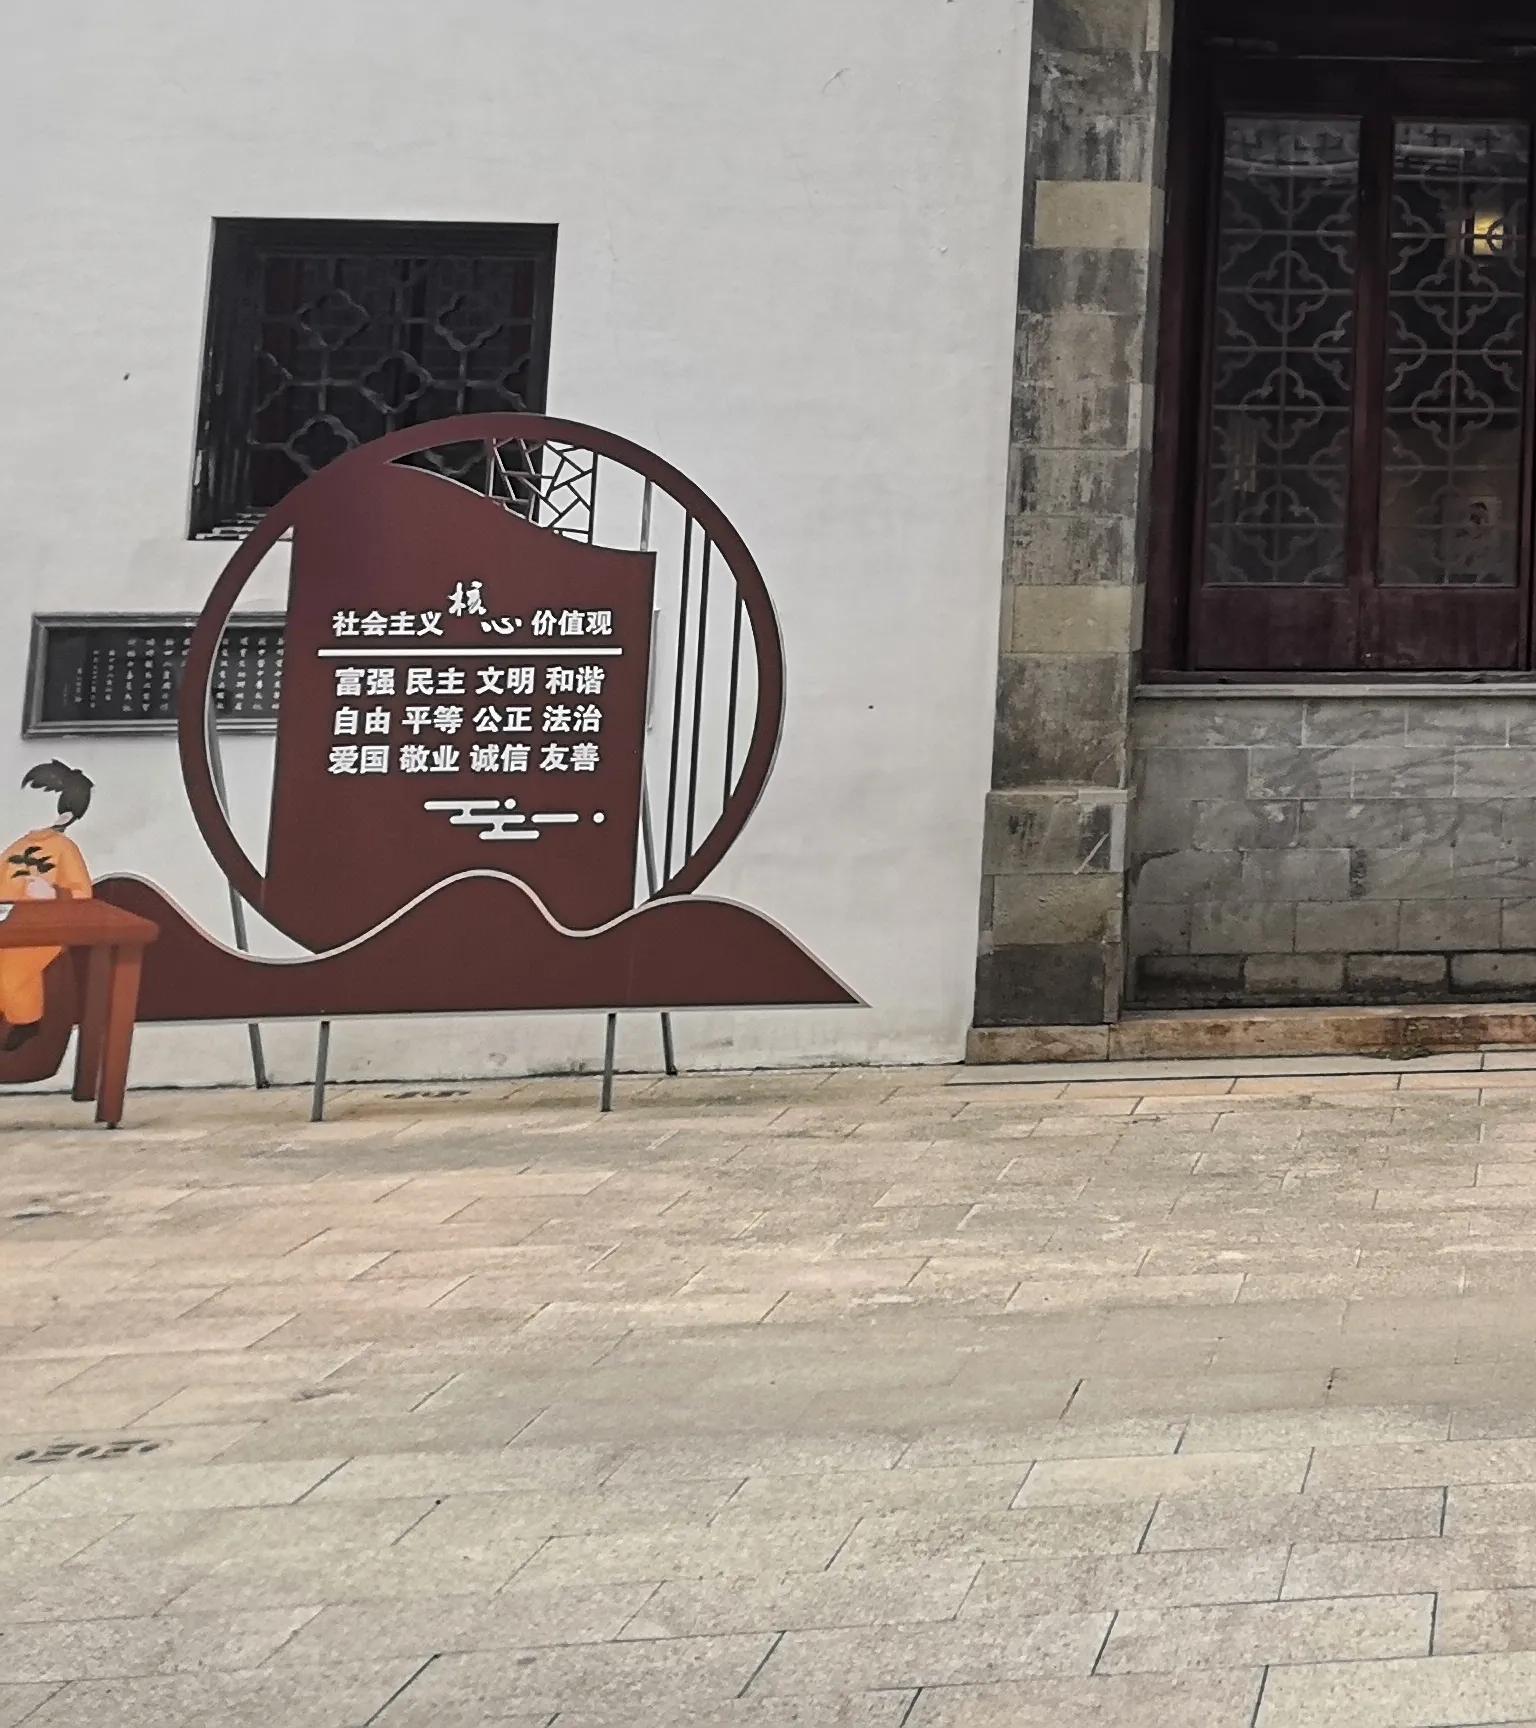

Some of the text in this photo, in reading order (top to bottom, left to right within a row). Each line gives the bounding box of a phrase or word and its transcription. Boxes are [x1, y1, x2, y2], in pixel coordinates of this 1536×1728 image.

[332, 580, 613, 637] 社会主义核心价值观
[335, 666, 605, 696] 富强 民主 文明 和谐
[334, 704, 602, 735] 自由 平等 公正 法治
[328, 742, 600, 774] 爱国 敬业 诚信 友善
